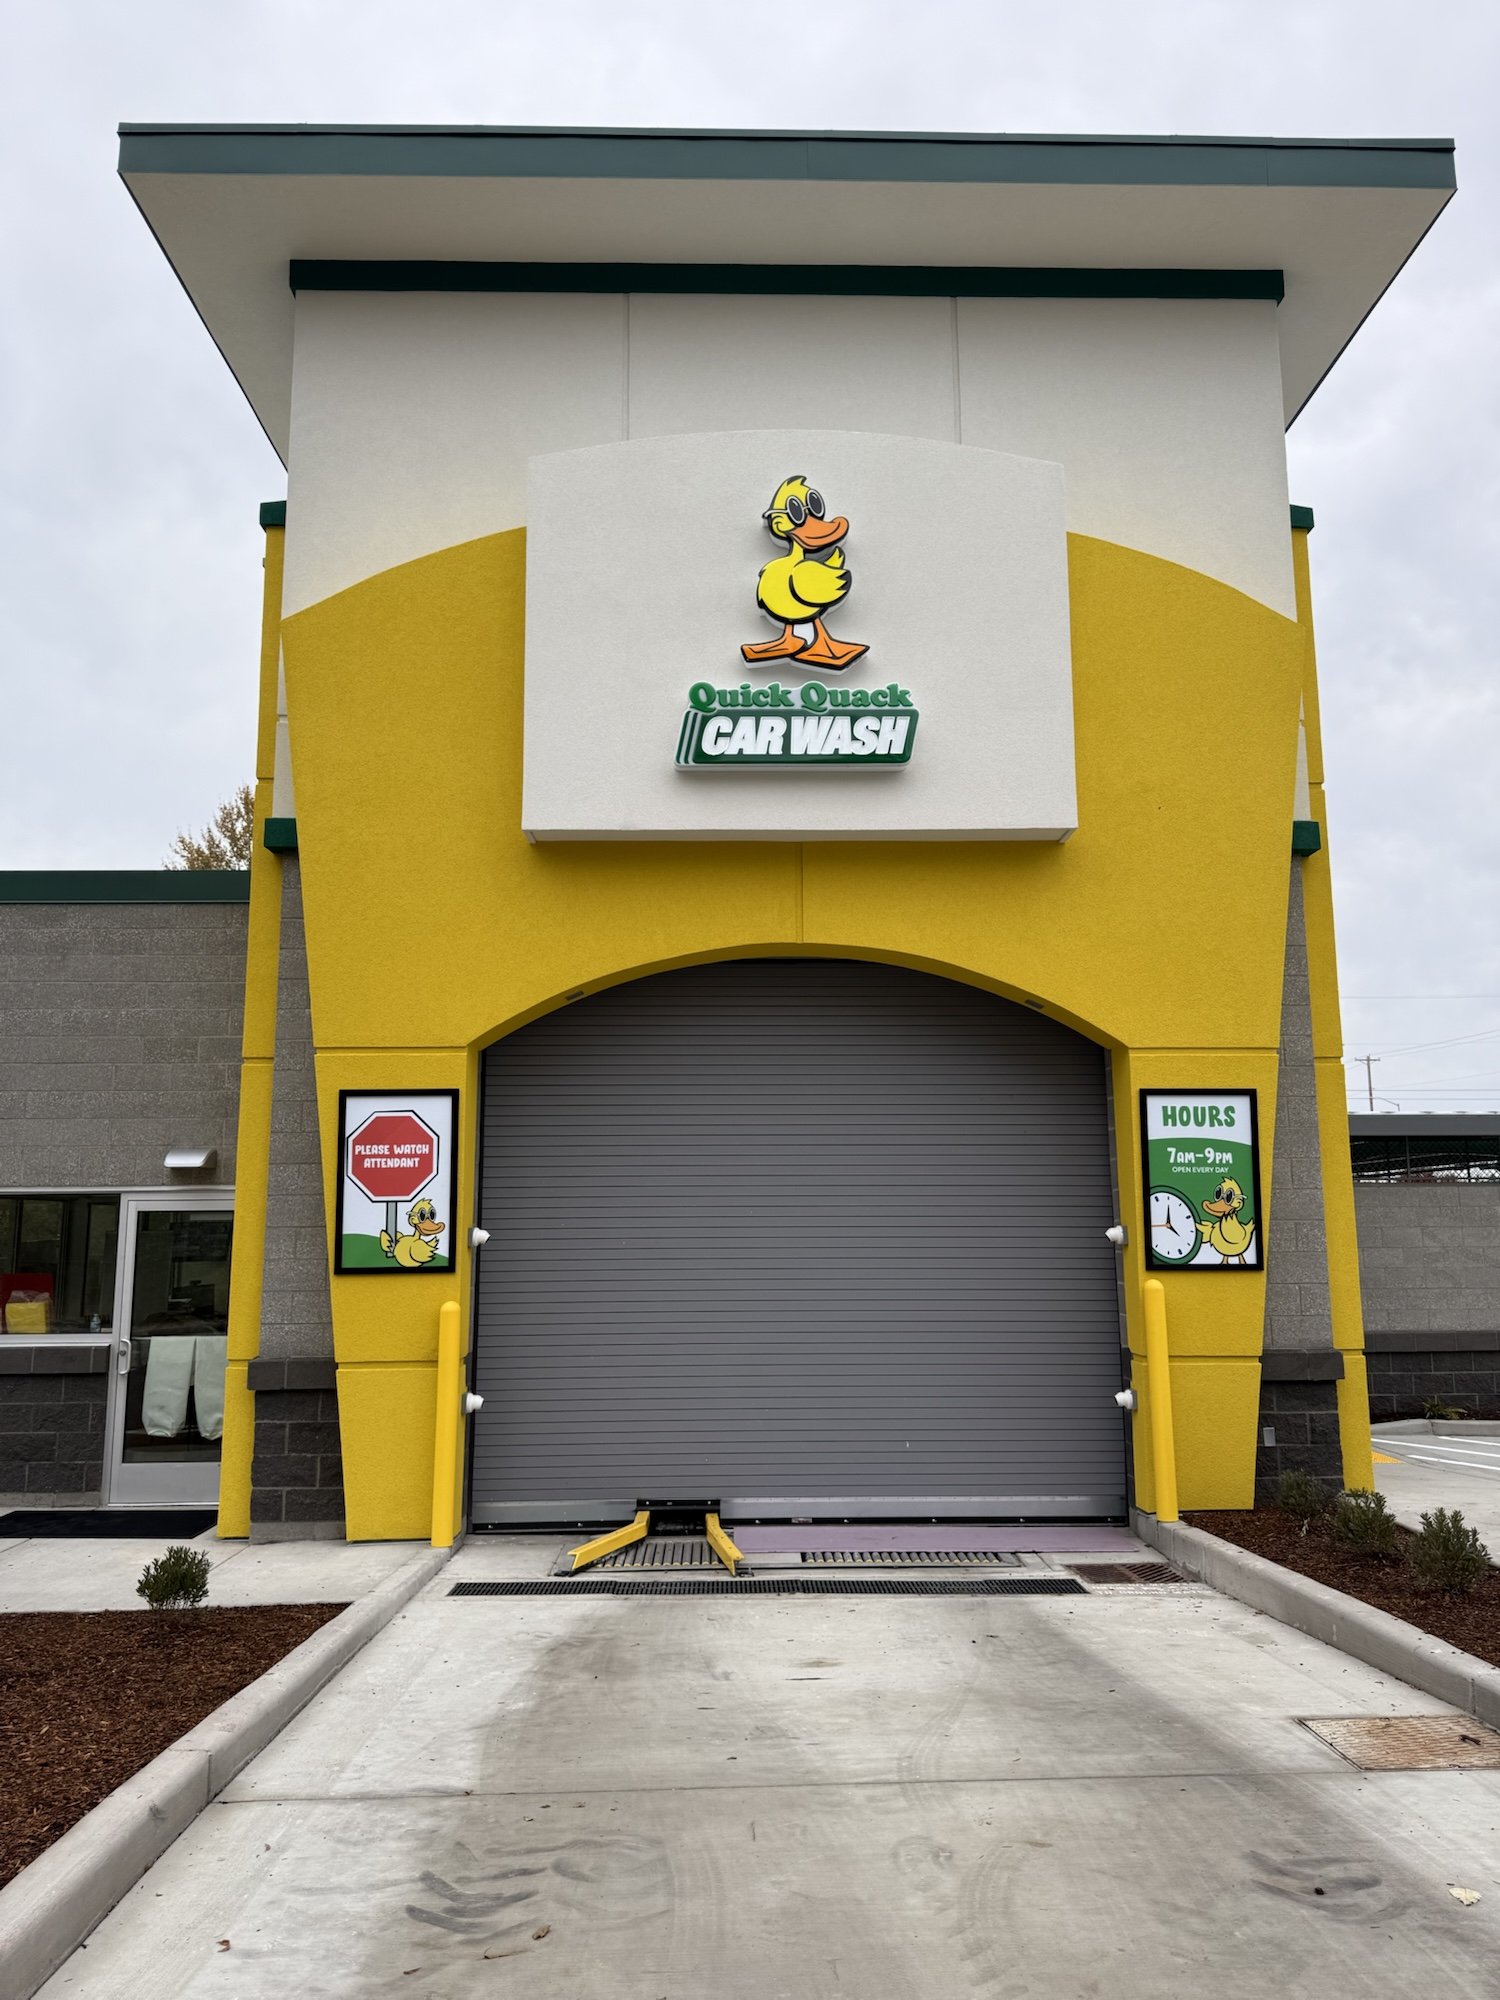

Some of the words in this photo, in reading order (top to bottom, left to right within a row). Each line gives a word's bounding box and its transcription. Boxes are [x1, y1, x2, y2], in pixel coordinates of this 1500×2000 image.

[688, 681, 794, 712] Quick
[800, 681, 914, 713] Quack
[701, 716, 787, 756] CAR
[790, 716, 911, 755] WASH
[1162, 1105, 1236, 1127] HOURS
[355, 1144, 390, 1155] PLEASE
[393, 1144, 430, 1155] WATCH
[363, 1157, 420, 1168] ATTENDANT
